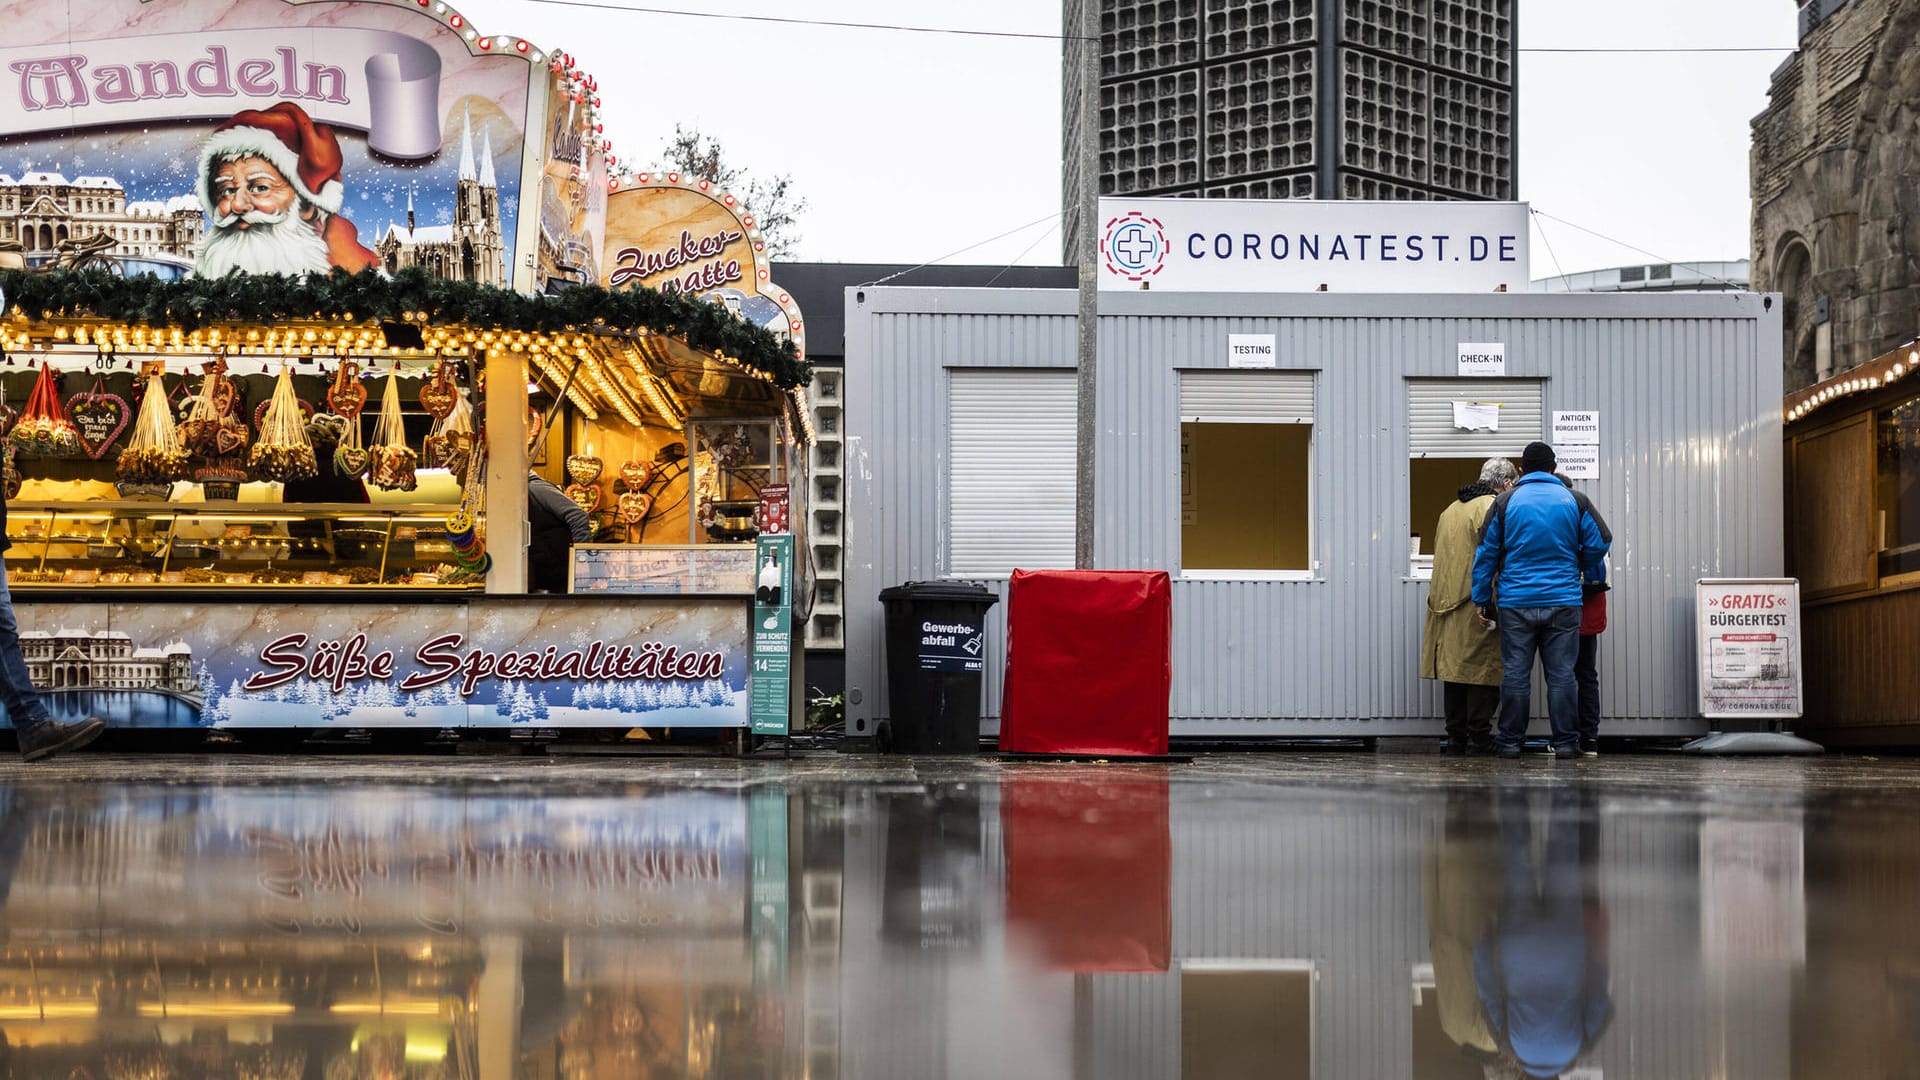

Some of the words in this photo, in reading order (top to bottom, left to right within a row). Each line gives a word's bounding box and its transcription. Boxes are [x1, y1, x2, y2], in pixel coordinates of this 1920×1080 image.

[9, 44, 351, 112] Mandeln
[1187, 233, 1516, 261] CORONATEST.DE
[609, 229, 743, 286] Zucker-
[1233, 345, 1272, 355] TESTING
[1460, 353, 1503, 364] CHECK-IN
[1721, 594, 1775, 609] GRATIS
[1710, 611, 1787, 625] BÜRGERTEST
[922, 622, 974, 634] Gewerbe-
[922, 635, 955, 646] abfall
[244, 632, 394, 694] Süße
[400, 632, 726, 696] Spezialitäten
[754, 659, 768, 672] 14
